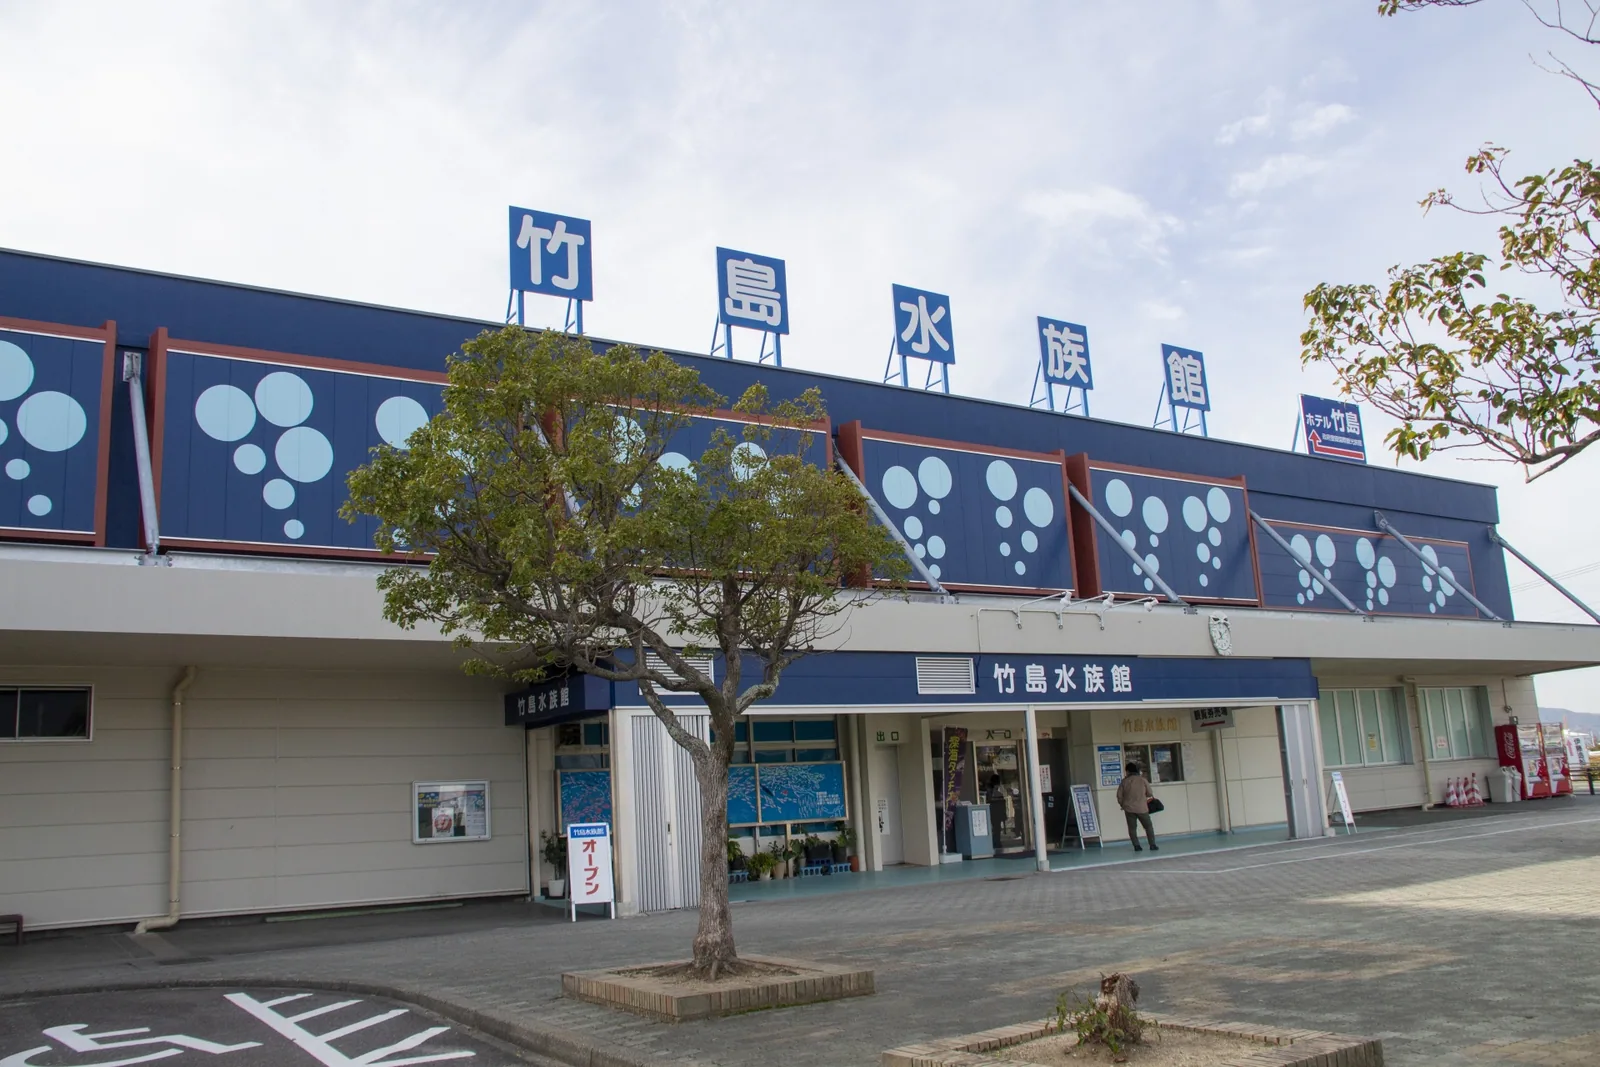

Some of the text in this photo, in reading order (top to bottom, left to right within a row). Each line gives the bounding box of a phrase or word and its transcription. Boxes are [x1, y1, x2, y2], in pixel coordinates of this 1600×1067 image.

[516, 214, 1205, 404] 竹 島 水 族 館
[1305, 408, 1361, 435] ホテル竹島
[993, 663, 1133, 695] 竹島水族館
[517, 687, 570, 717] 竹島水族館
[876, 730, 900, 742] 出口
[986, 729, 1012, 740] 入口
[1122, 715, 1178, 733] 竹島水族館
[582, 838, 600, 896] オープン
